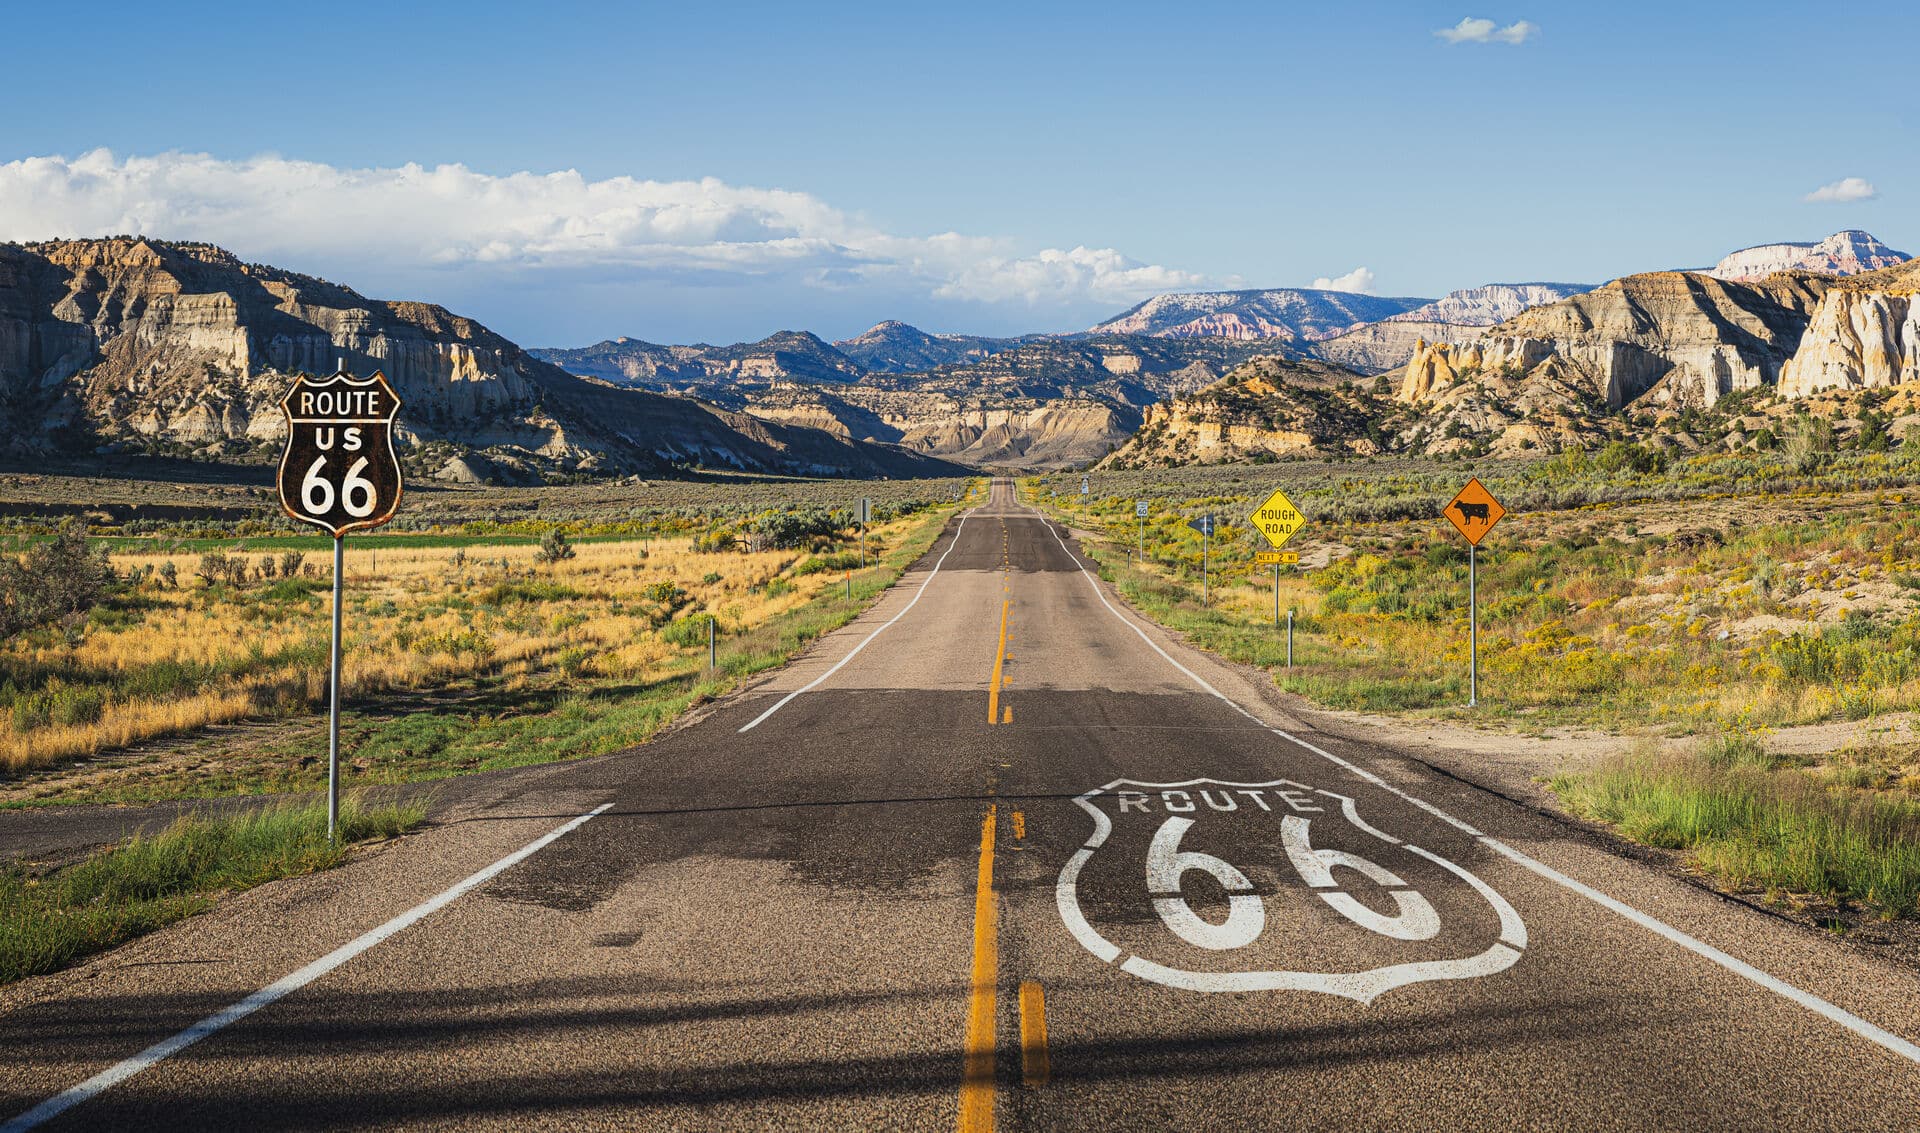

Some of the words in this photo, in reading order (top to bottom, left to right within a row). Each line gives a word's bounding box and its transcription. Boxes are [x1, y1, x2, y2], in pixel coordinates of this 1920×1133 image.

[301, 391, 380, 415] ROUTE
[301, 454, 377, 518] 66
[1261, 509, 1295, 521] ROUGH
[1265, 523, 1292, 534] ROAD
[1279, 553, 1284, 562] 2
[1118, 790, 1325, 813] ROUTE
[1146, 815, 1441, 950] 66
